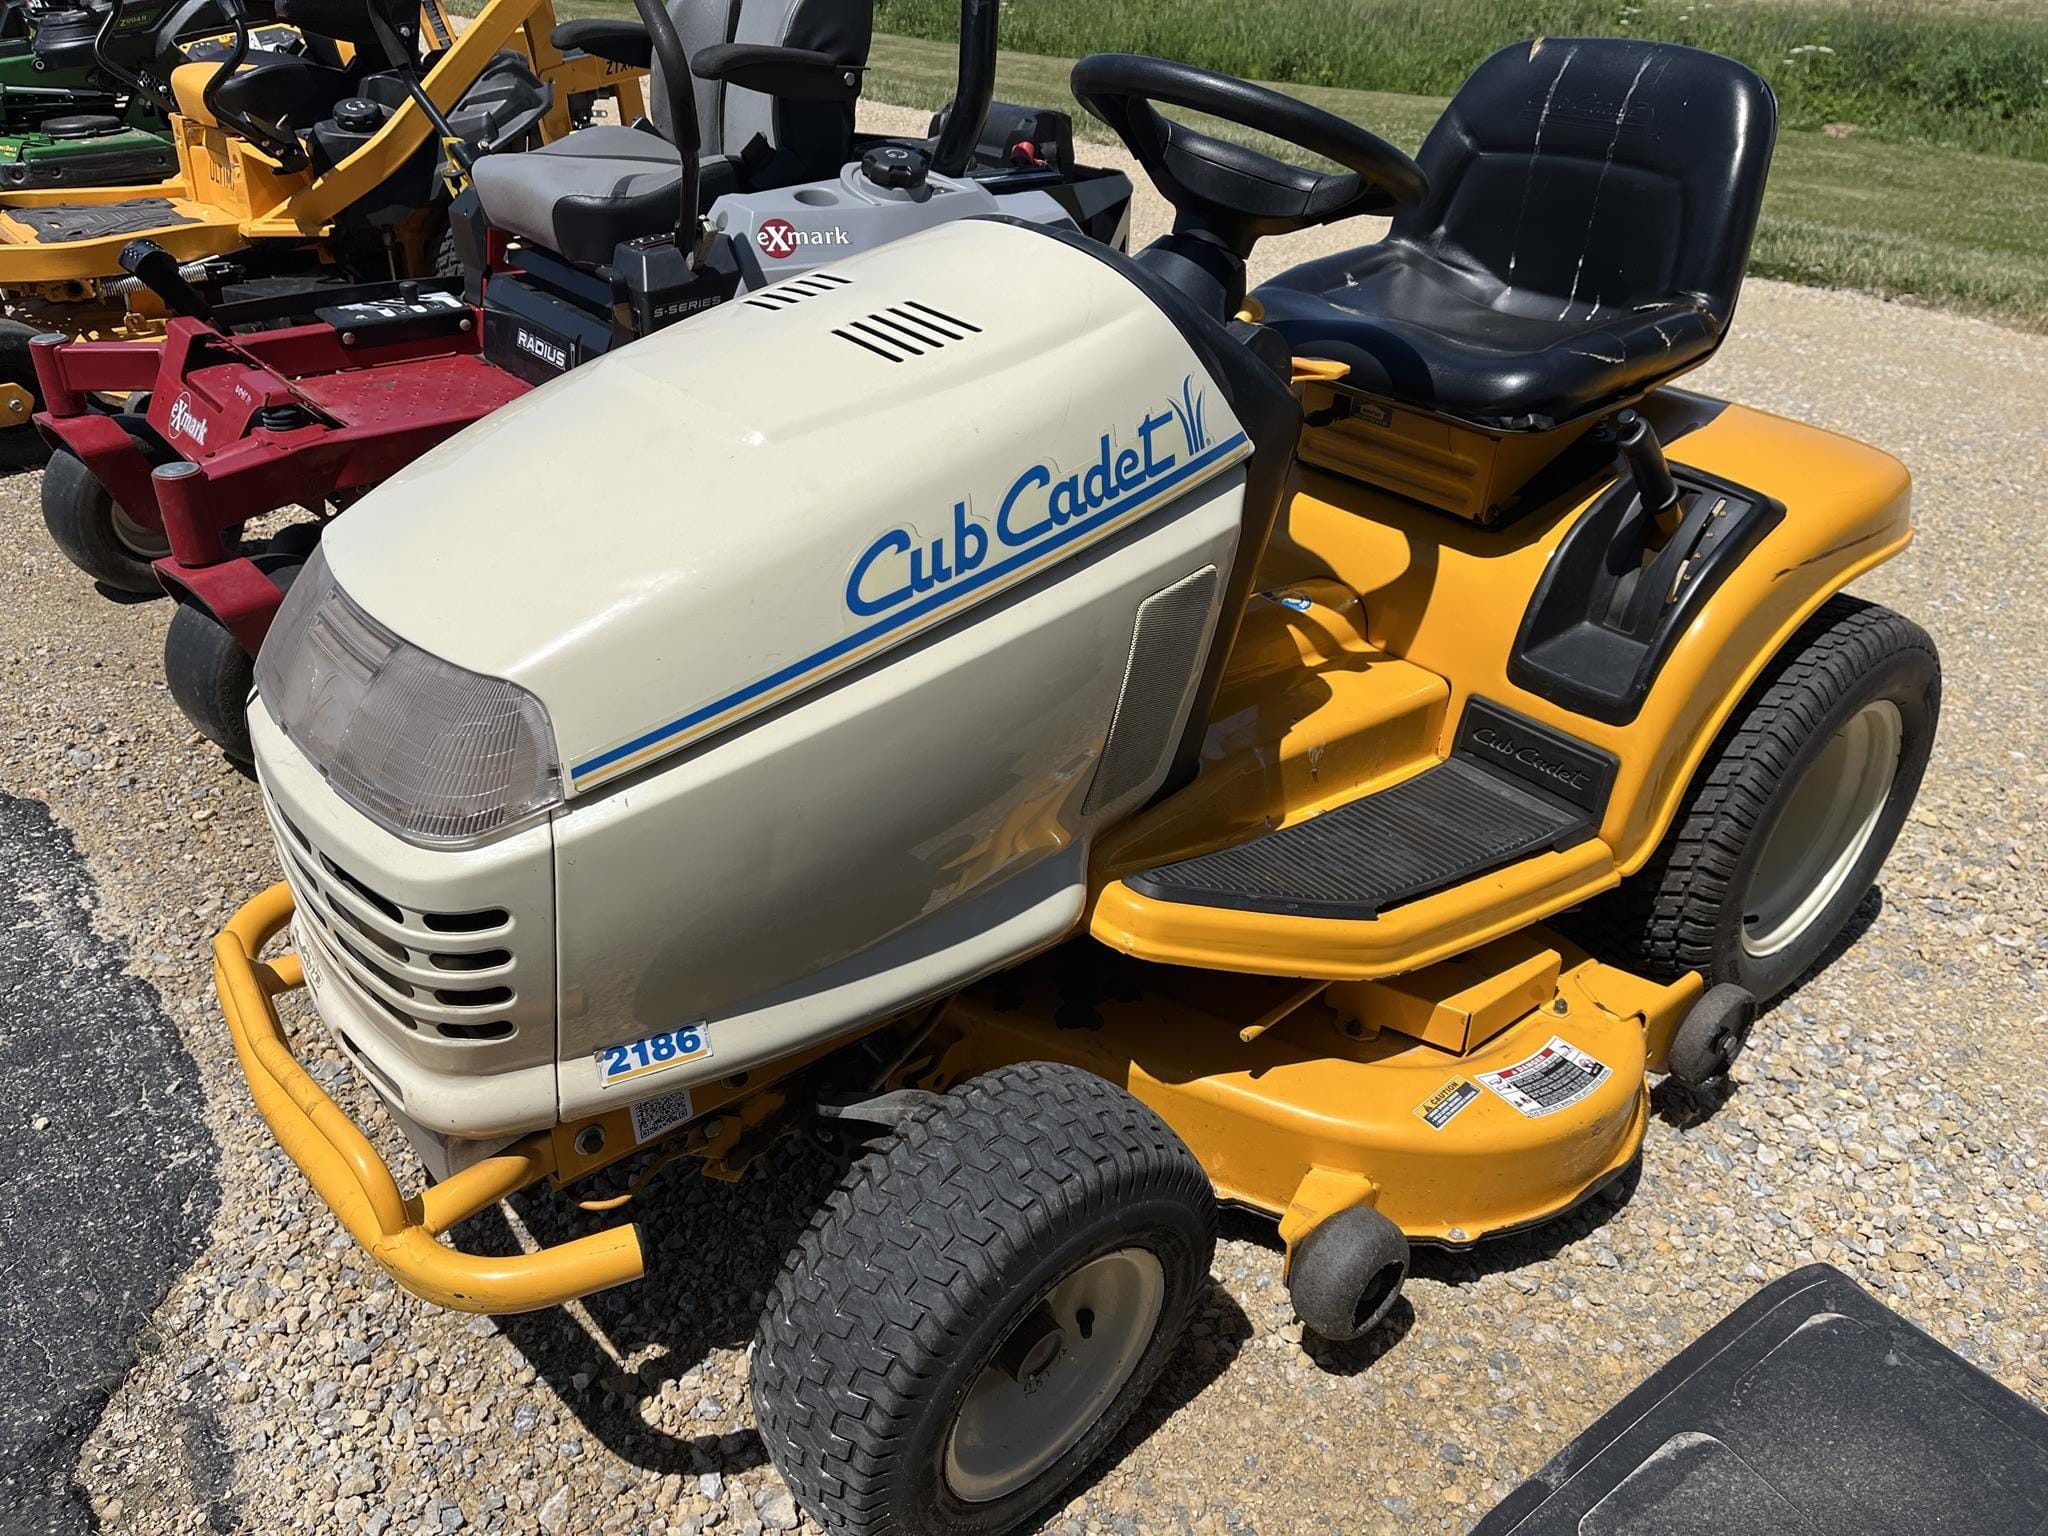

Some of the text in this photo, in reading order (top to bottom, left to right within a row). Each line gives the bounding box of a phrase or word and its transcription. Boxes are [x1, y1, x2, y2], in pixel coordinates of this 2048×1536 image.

[756, 225, 850, 252] eXmark
[516, 327, 567, 371] RADIUS
[170, 397, 209, 446] eXmark
[845, 408, 1176, 617] Cub Cadet
[1472, 726, 1591, 791] Cub Cadet
[603, 1025, 701, 1076] 2186
[1516, 1053, 1547, 1072] DANGER
[1429, 1081, 1460, 1105] CAUTION
